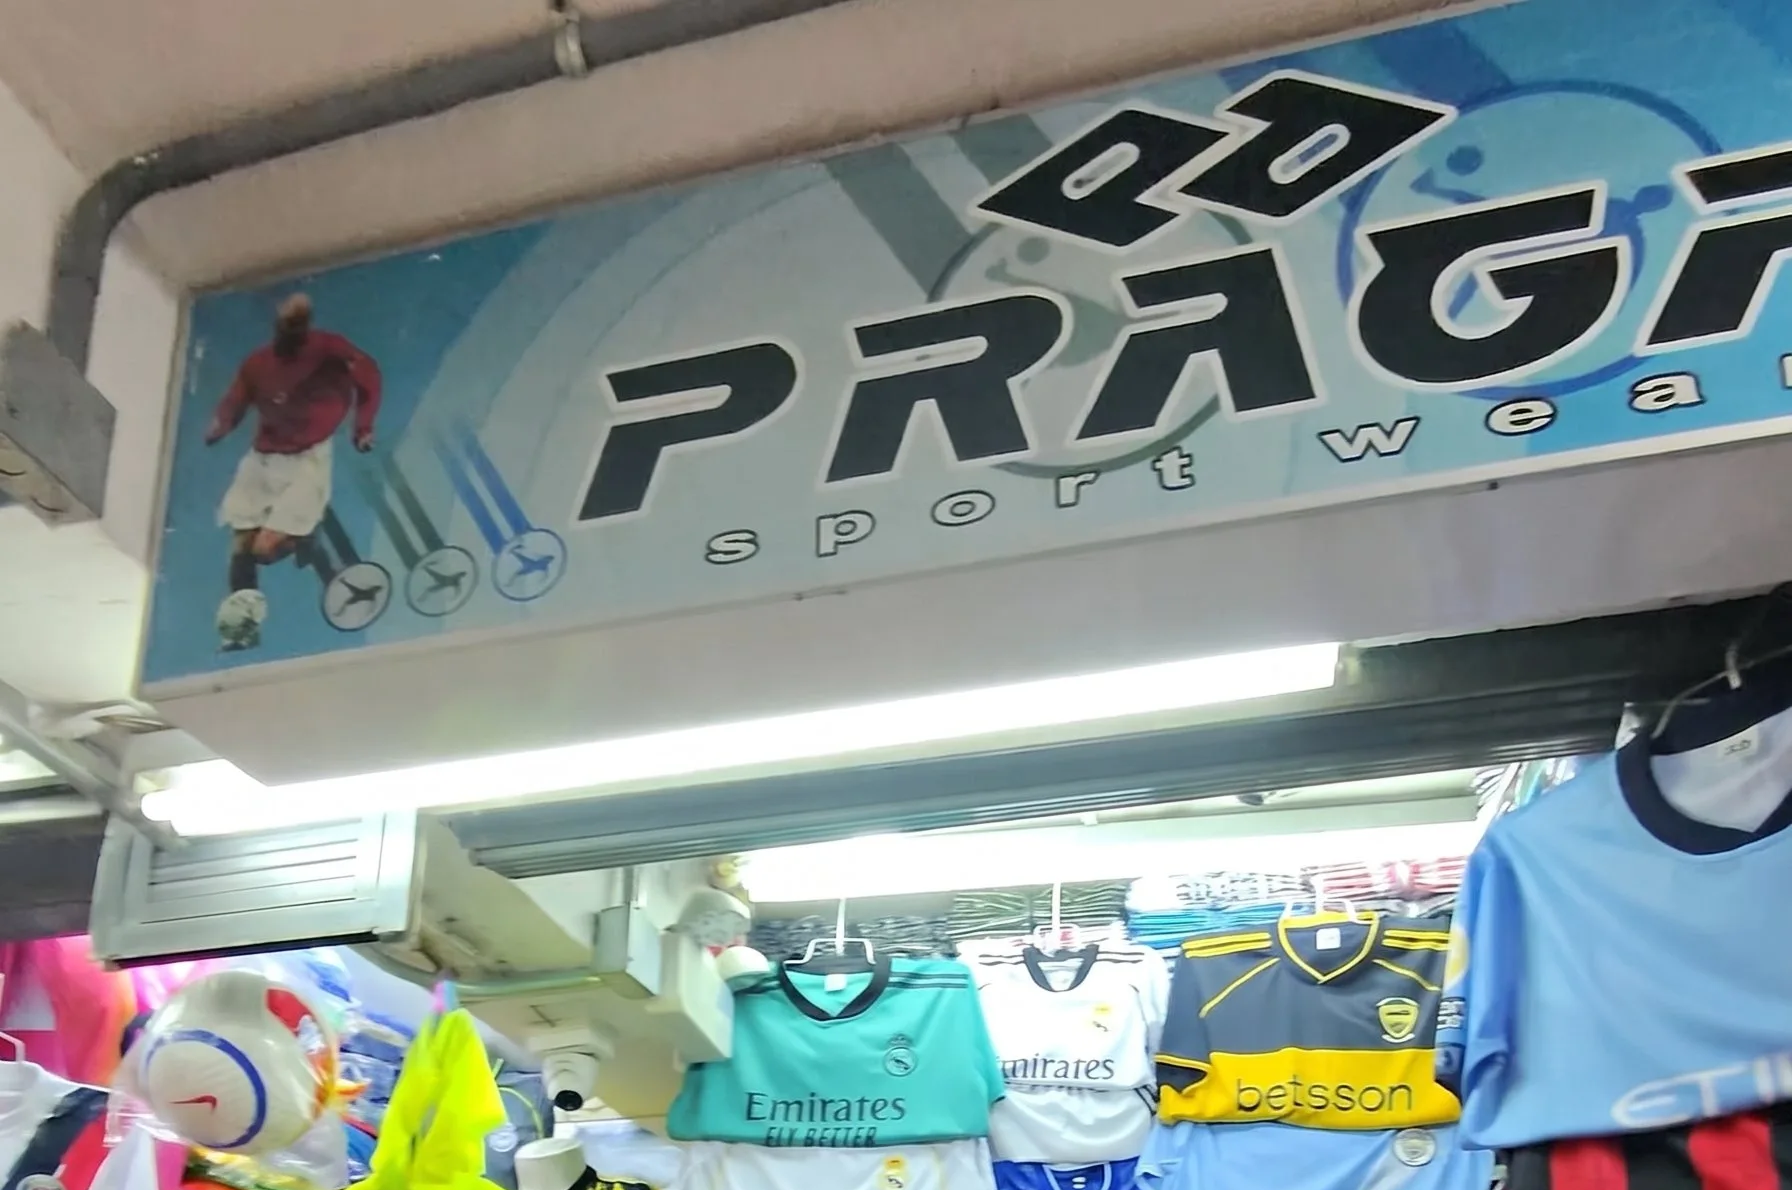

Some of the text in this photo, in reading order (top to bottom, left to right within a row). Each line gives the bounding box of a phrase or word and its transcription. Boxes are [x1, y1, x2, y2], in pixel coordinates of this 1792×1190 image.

[704, 352, 1792, 565] sport wea
[999, 1052, 1115, 1080] mirates
[744, 1091, 907, 1123] Emirates
[1235, 1073, 1413, 1113] betsson
